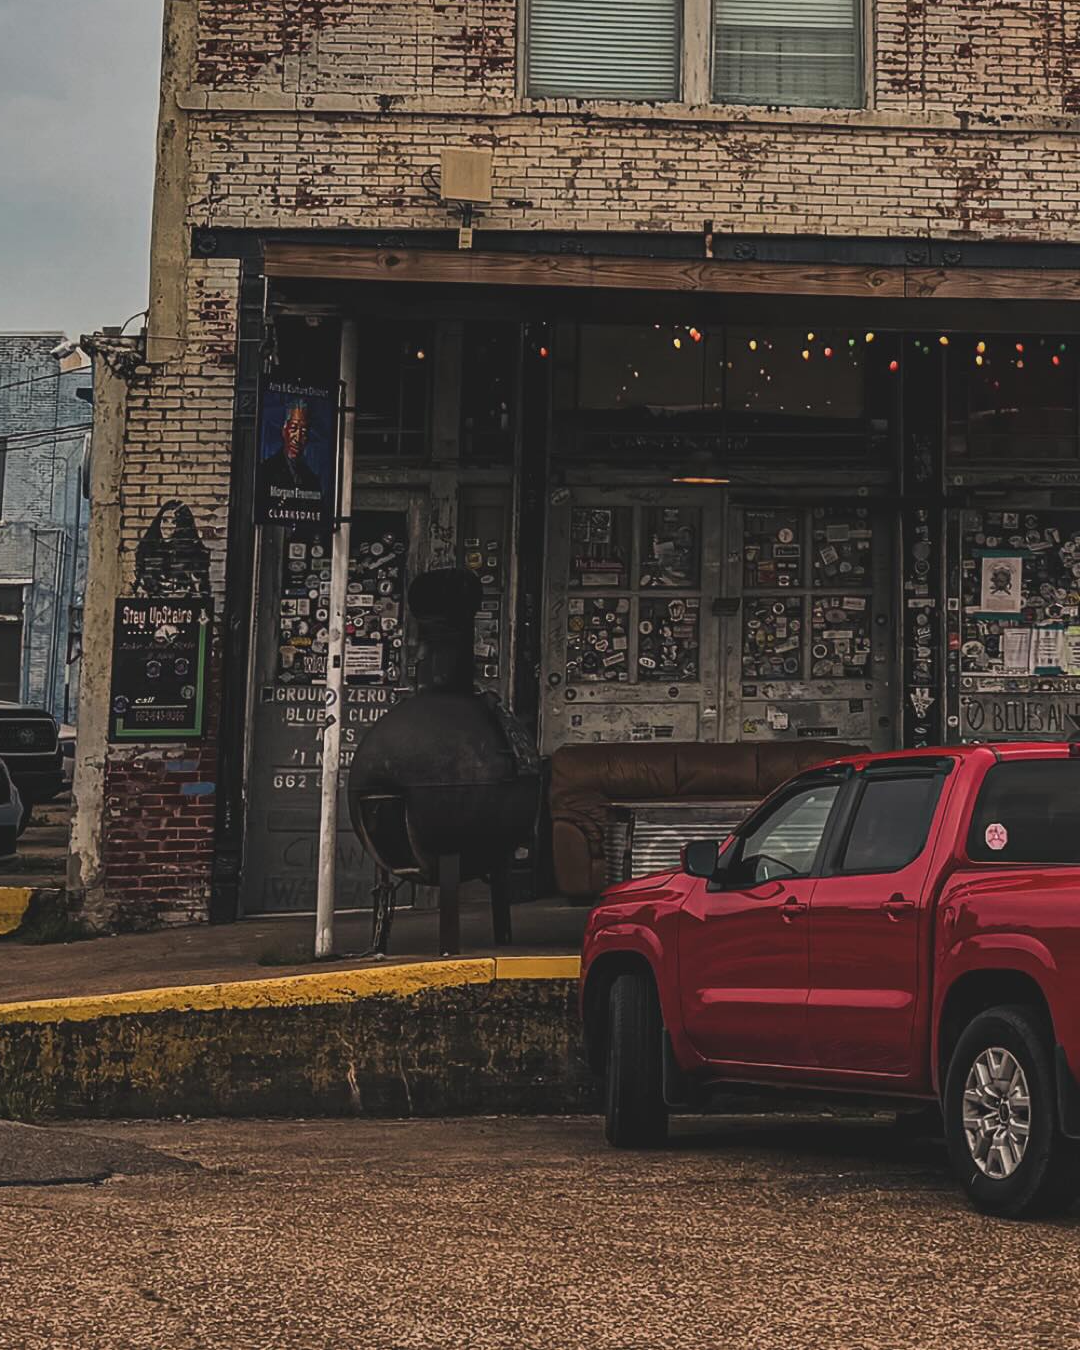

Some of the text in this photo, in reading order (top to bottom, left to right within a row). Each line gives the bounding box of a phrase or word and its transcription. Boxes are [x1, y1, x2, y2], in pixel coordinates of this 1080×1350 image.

[270, 485, 294, 500] Morgan
[268, 508, 321, 521] CLARKSDALE
[122, 605, 147, 629] Stay
[276, 687, 387, 702] GROUN ZERO
[286, 707, 327, 722] BLUE
[993, 701, 1044, 731] BLUES
